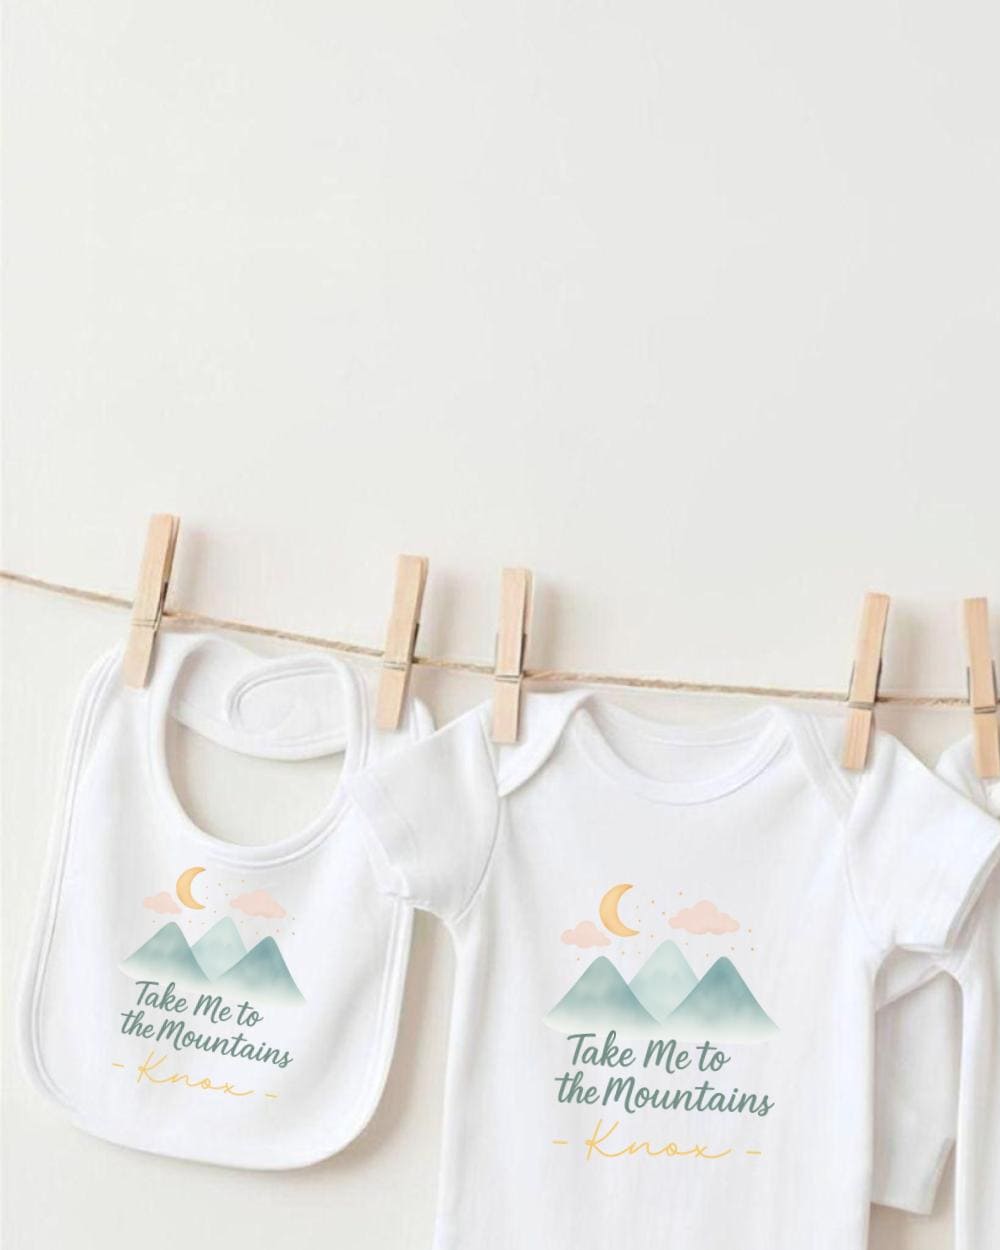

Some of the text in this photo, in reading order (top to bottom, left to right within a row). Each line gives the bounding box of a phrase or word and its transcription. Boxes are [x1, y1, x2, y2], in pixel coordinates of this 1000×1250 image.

[135, 980, 264, 1027] Take Me to
[120, 1010, 294, 1069] the Mountains
[567, 1030, 731, 1074] Take Me to
[137, 1051, 254, 1097] Knox
[554, 1070, 775, 1117] the Mountains
[584, 1118, 732, 1161] Knox
